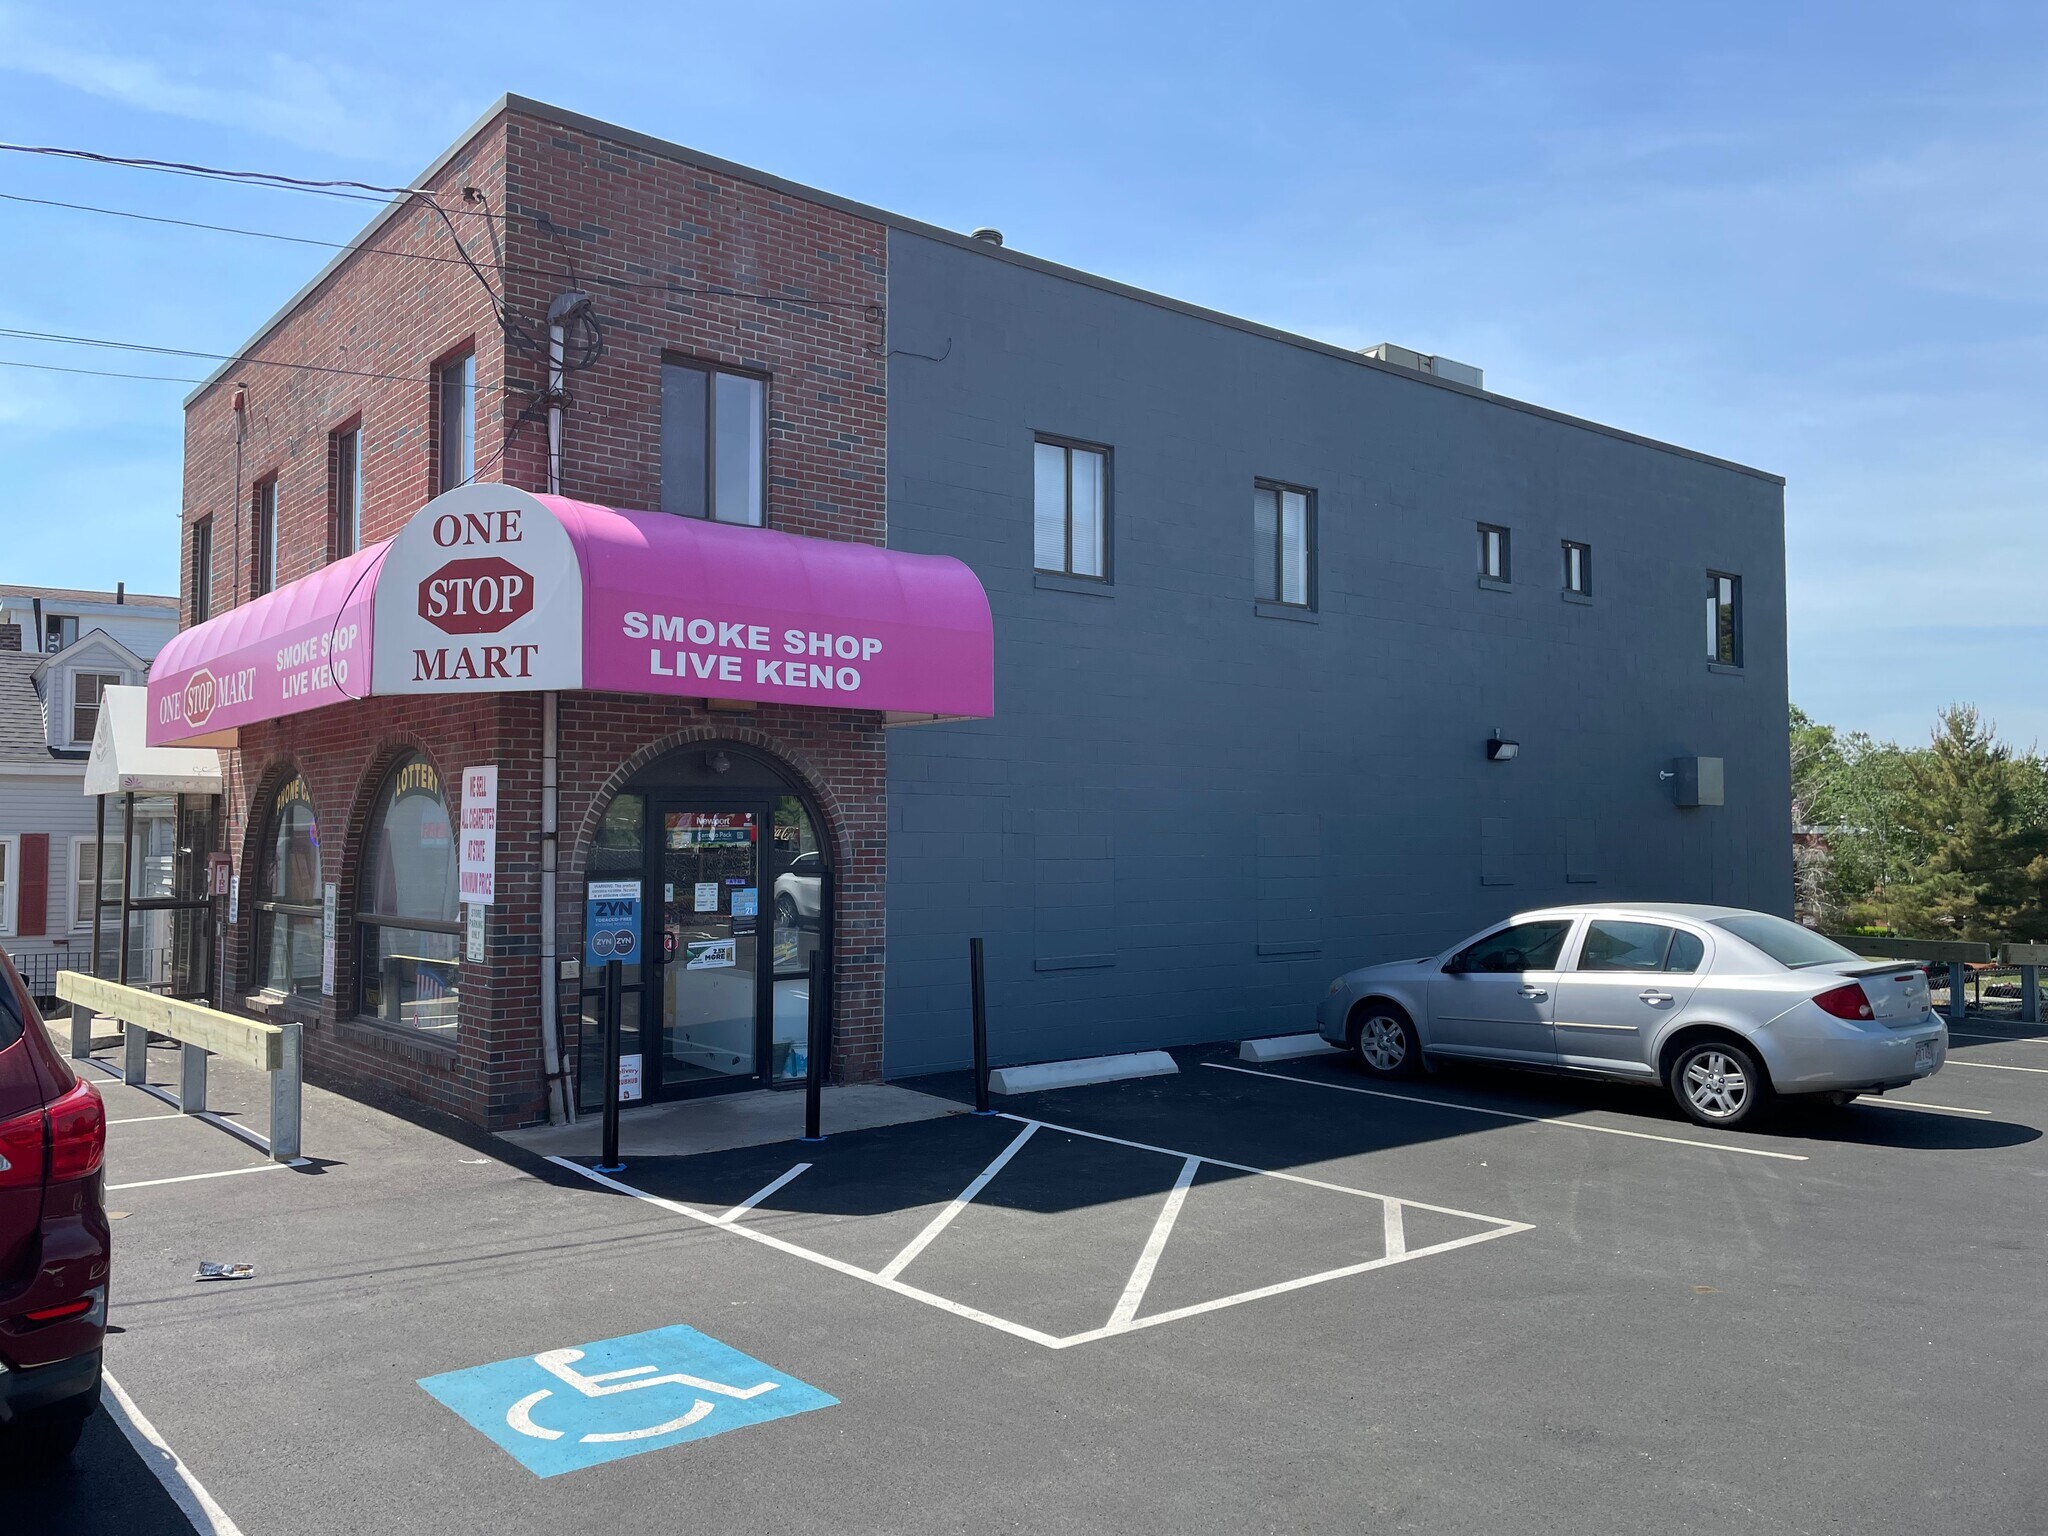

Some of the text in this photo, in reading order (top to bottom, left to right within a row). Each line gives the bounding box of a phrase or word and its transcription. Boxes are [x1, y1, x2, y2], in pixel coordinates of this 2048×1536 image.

[432, 509, 523, 547] ONE
[427, 575, 524, 618] STOP
[276, 624, 358, 672] SMOKE SHOP
[622, 611, 883, 661] SMOKE SHOP
[412, 644, 539, 682] MART
[650, 648, 861, 692] LIVE KENO
[282, 659, 348, 700] LIVE KENO
[159, 667, 256, 725] ONE STOP MART
[396, 762, 439, 796] LOTTERY
[469, 776, 486, 797] WE SELL
[276, 779, 300, 817] PHONE
[461, 808, 495, 829] ALL CIGARETTES
[696, 816, 730, 827] Newport
[468, 840, 473, 861] AT
[218, 865, 227, 893] FIRE
[479, 872, 492, 895] PRICE
[471, 909, 482, 918] STORE
[595, 901, 632, 916] ZYN
[469, 919, 483, 929] PARKING
[597, 938, 612, 946] ZYN
[616, 937, 631, 945] ZYN
[704, 953, 725, 961] MORE
